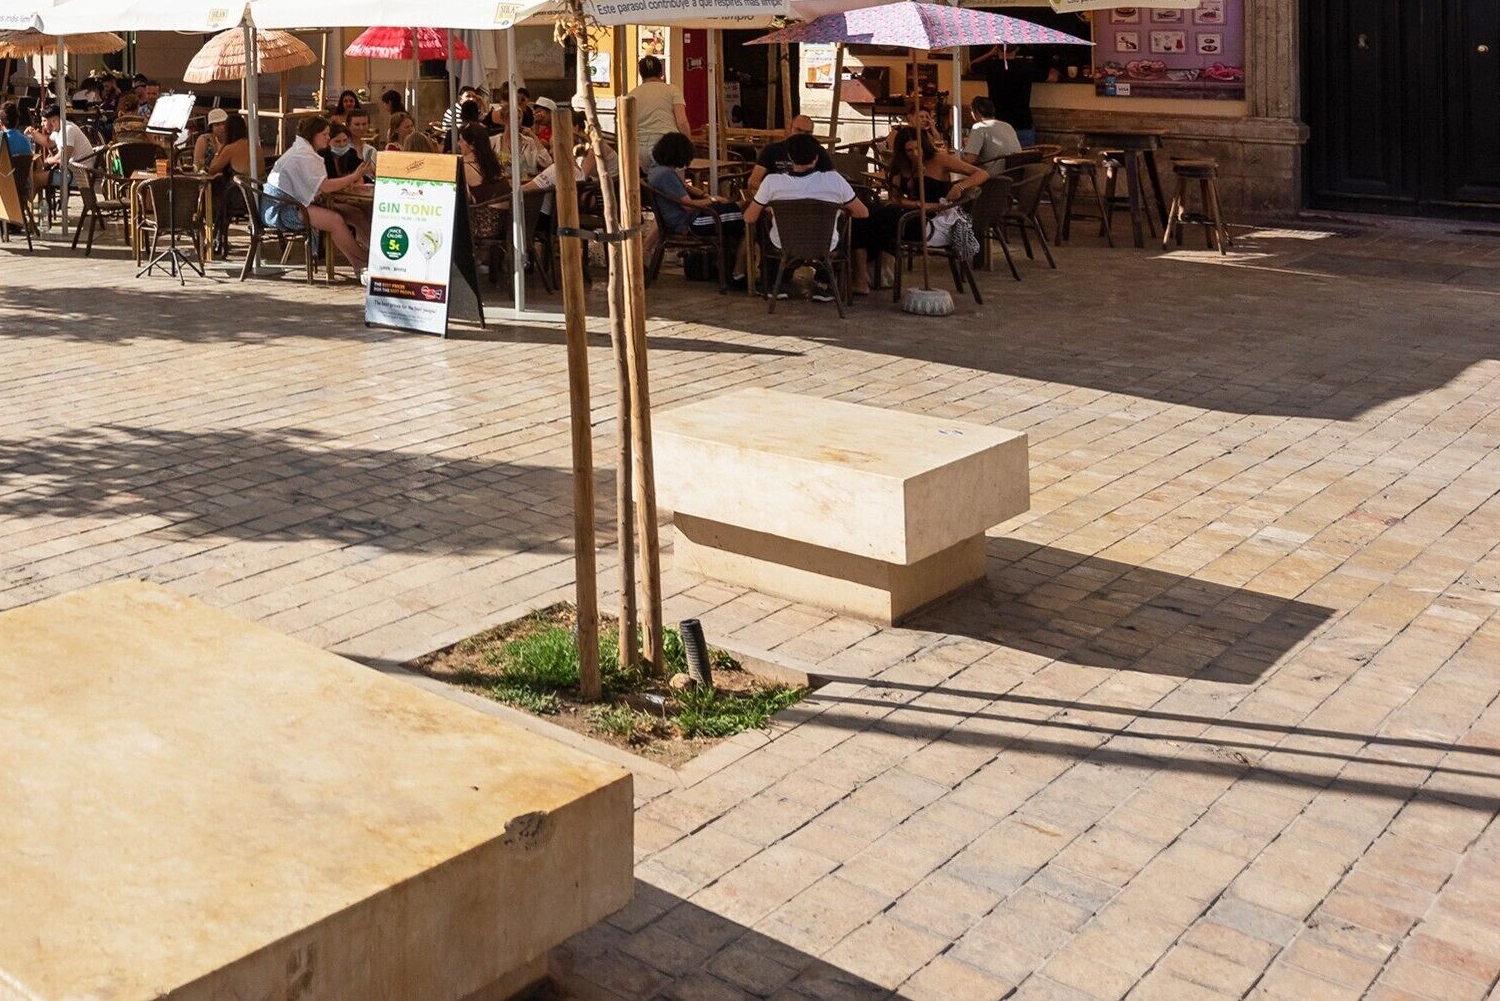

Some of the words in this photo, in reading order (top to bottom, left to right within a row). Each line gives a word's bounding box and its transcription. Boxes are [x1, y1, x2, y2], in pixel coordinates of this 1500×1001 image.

[596, 4, 617, 15] Este
[617, 0, 647, 14] parasol
[692, 0, 698, 7] a
[698, 0, 713, 9] que
[378, 202, 400, 213] GIN
[404, 203, 442, 217] TONIC
